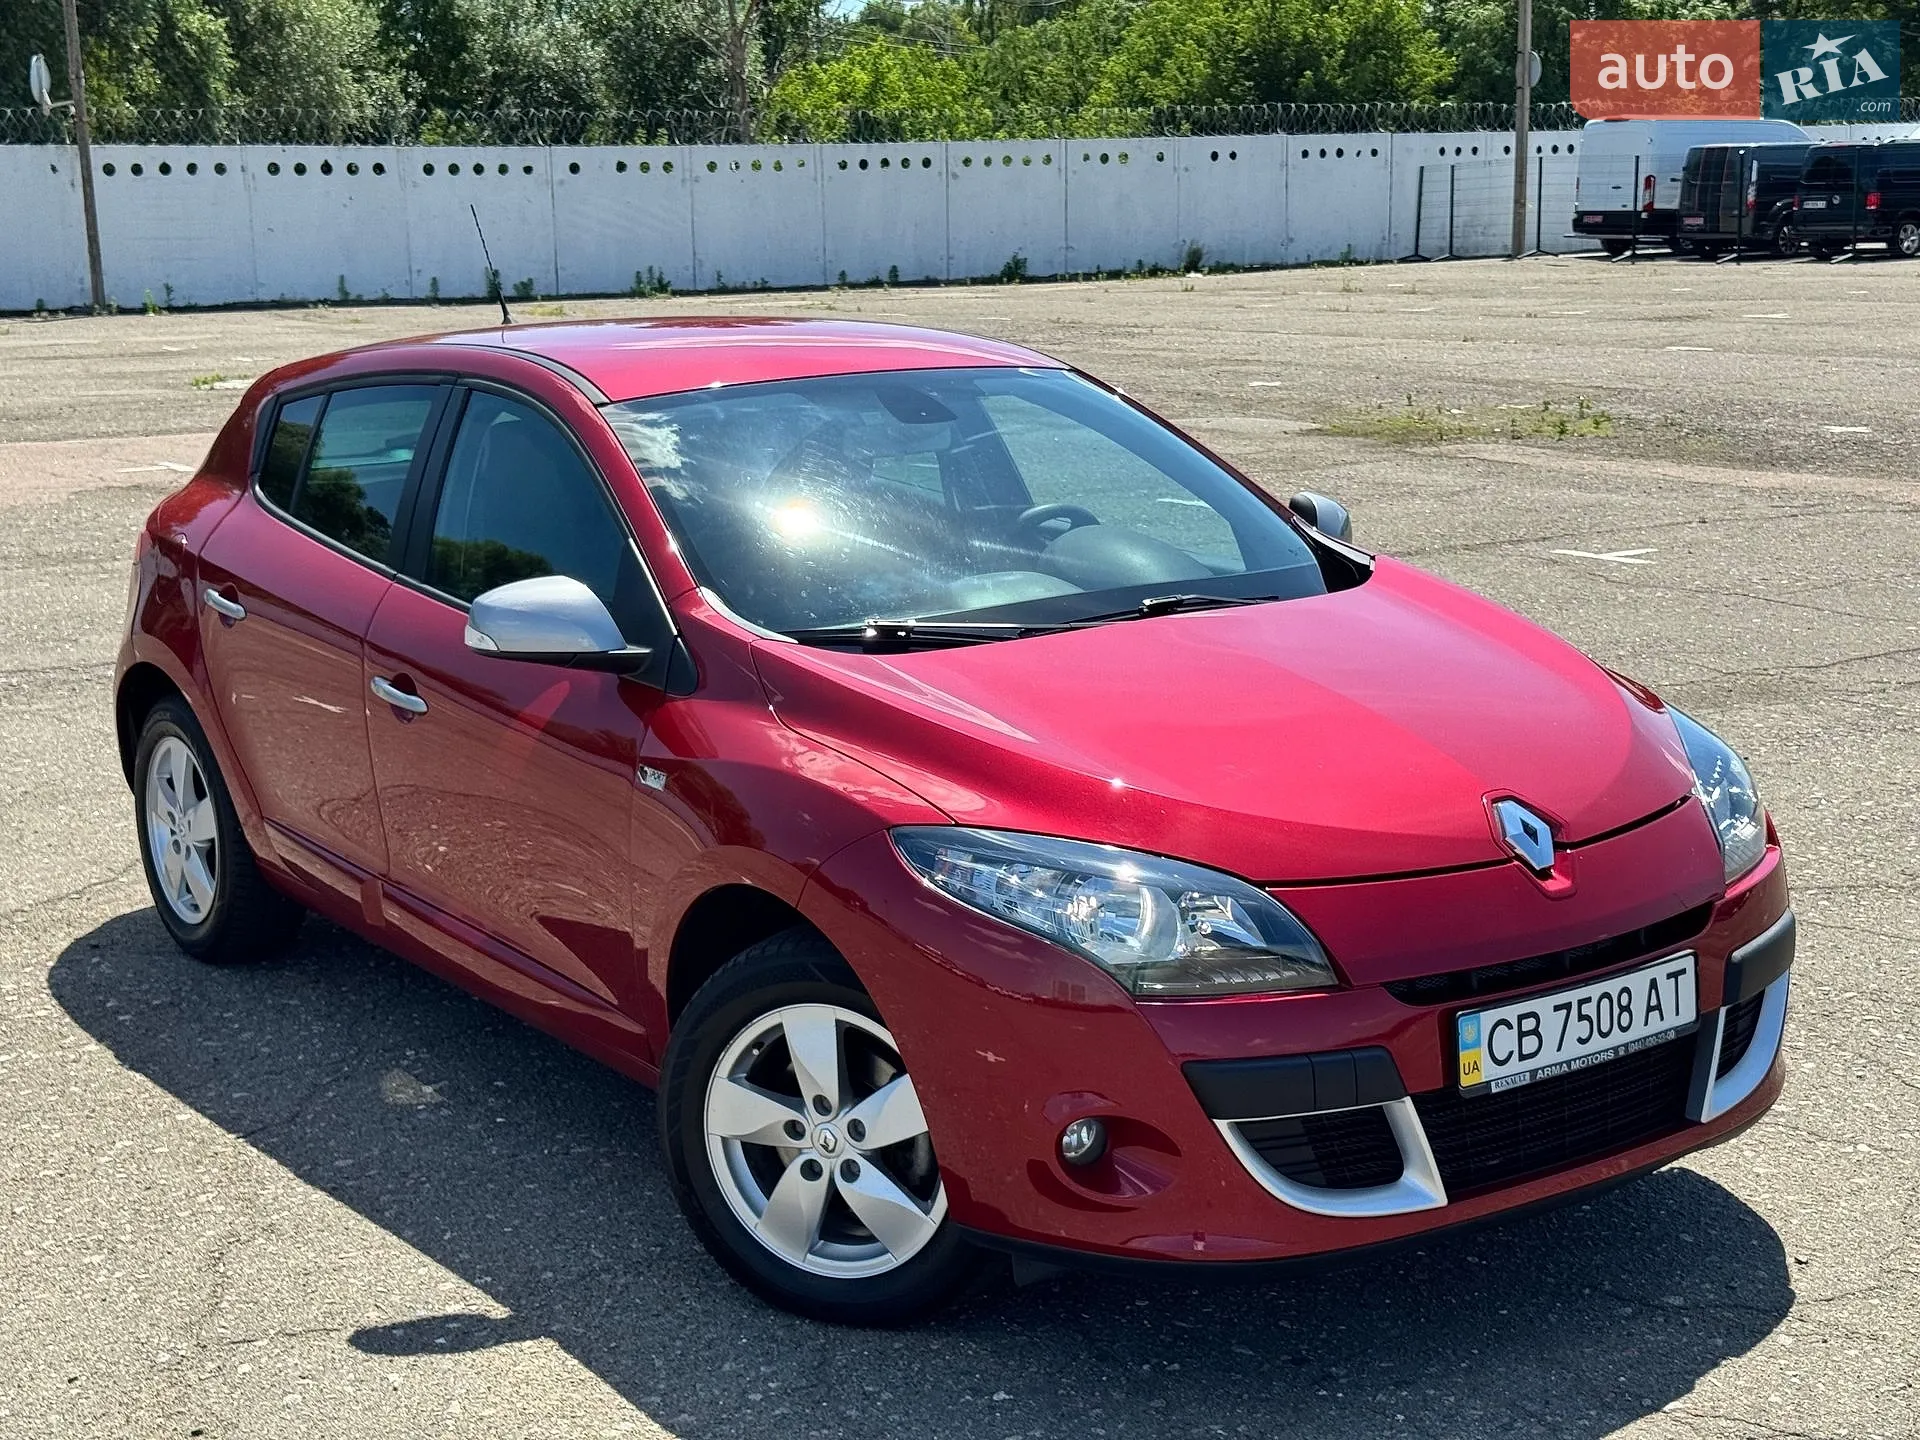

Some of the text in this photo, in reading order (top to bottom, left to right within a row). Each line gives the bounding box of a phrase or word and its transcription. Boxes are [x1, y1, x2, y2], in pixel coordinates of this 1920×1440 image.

[1487, 968, 1687, 1066] CB 7508 AT
[1463, 1060, 1480, 1076] UA
[1536, 1064, 1568, 1080] ARMA
[1571, 1050, 1614, 1069] MOTORS
